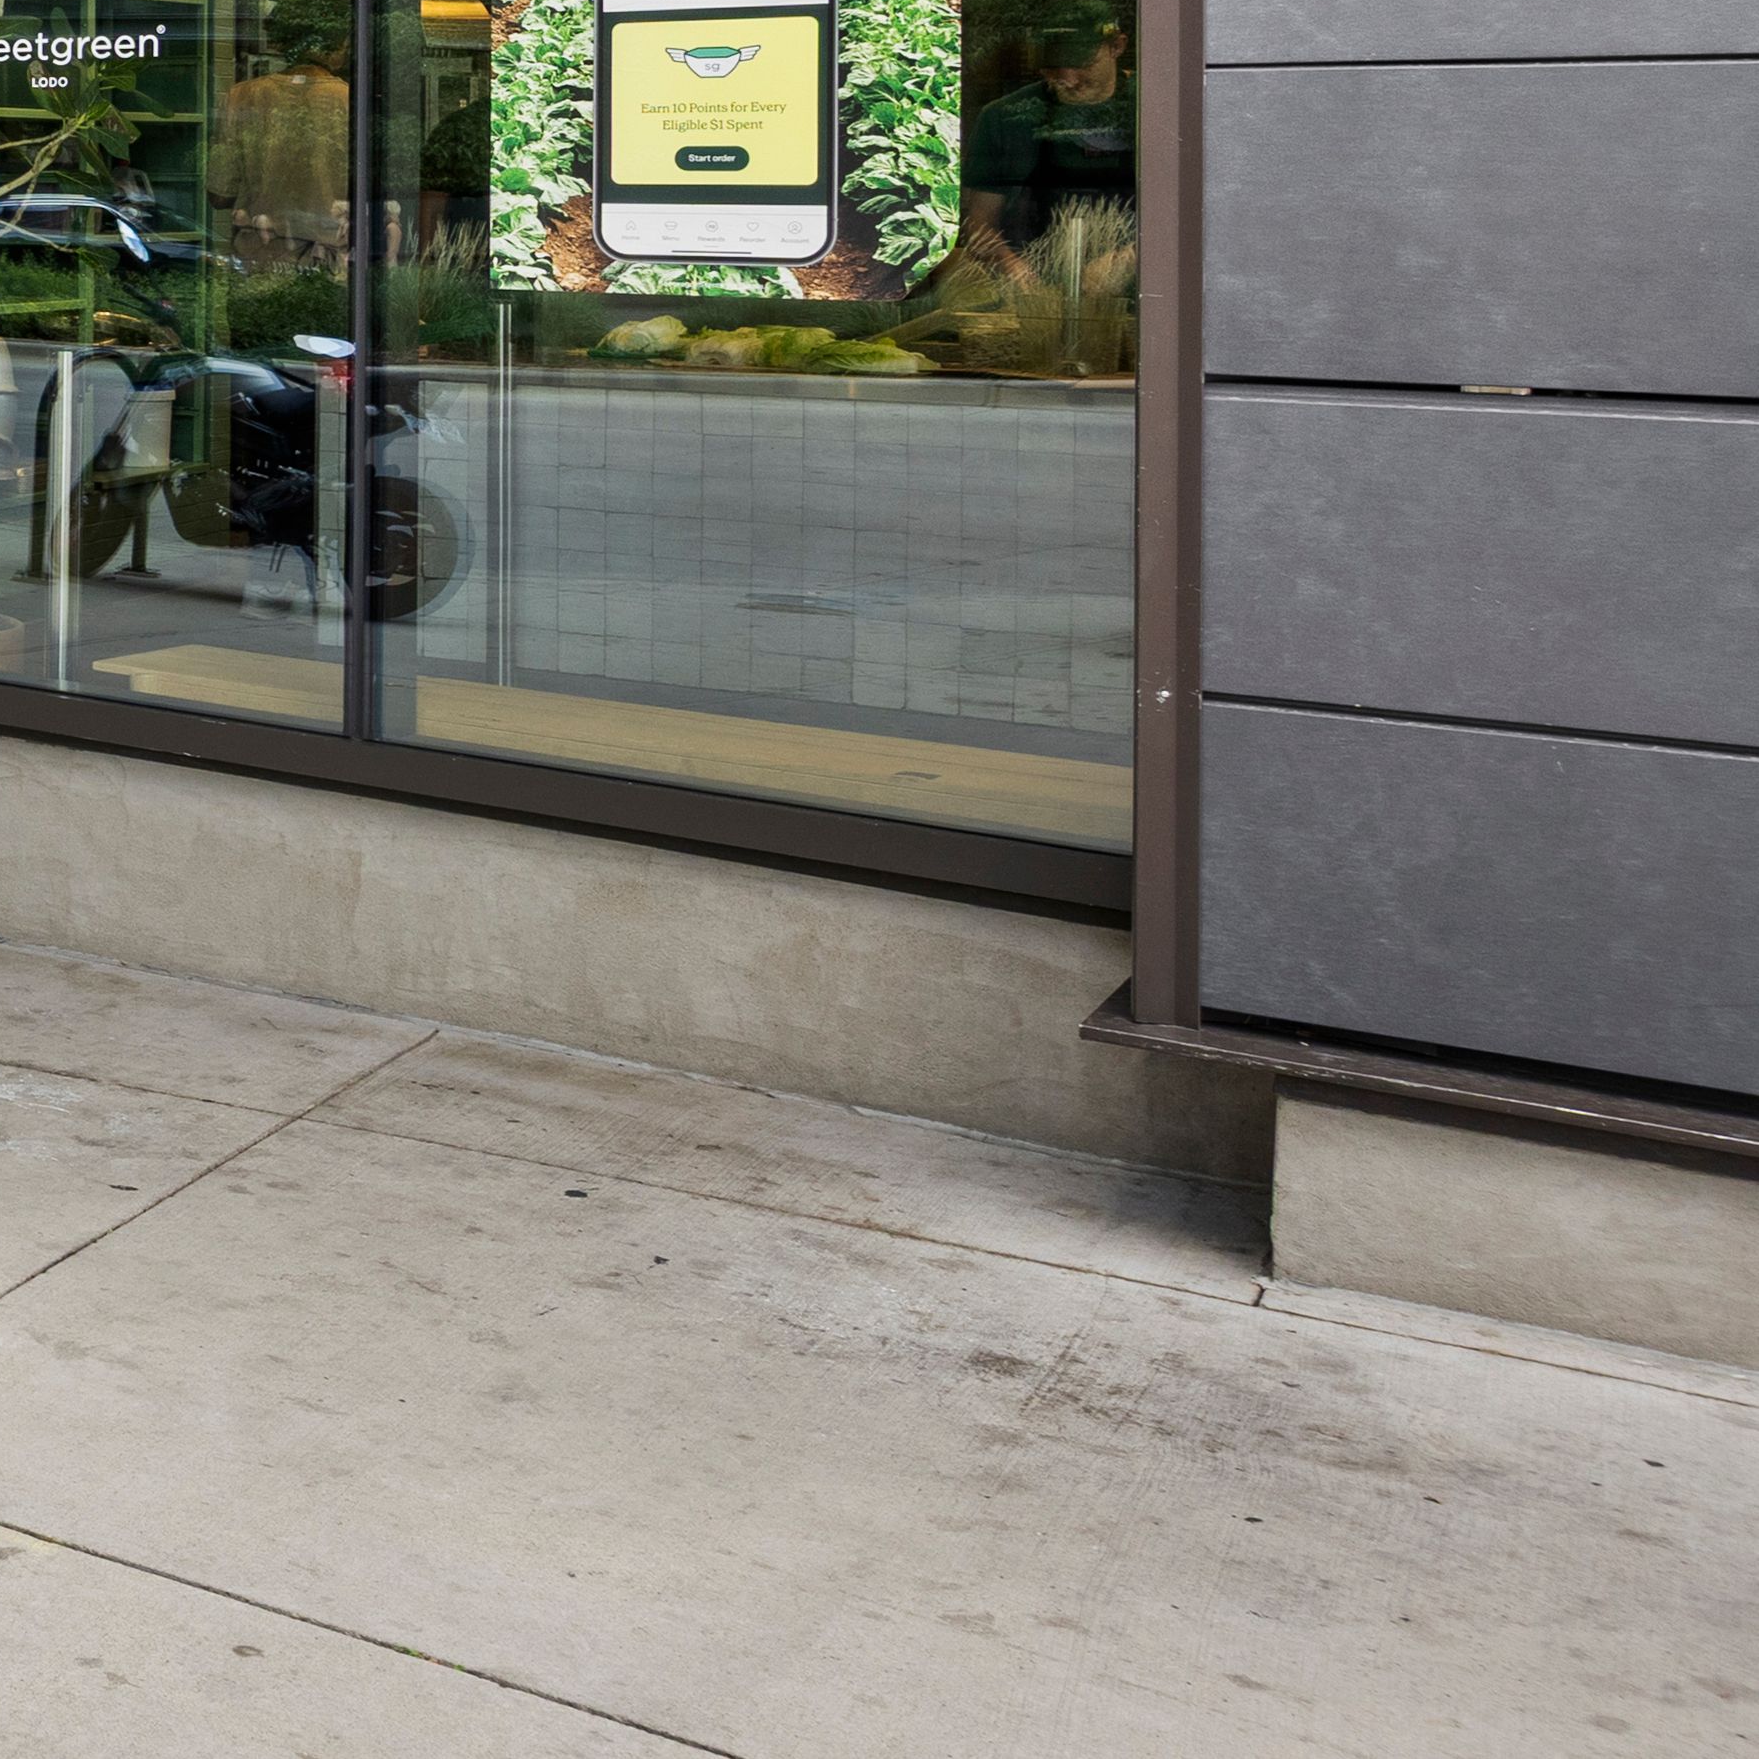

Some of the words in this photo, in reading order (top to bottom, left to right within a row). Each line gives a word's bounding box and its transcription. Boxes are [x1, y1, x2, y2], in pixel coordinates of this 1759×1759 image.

[704, 62, 720, 72] sg
[31, 76, 69, 88] LODO
[641, 103, 670, 114] Earn
[672, 103, 687, 113] 10
[689, 102, 728, 113] Points
[730, 101, 748, 113] for
[751, 101, 787, 115] Every
[662, 120, 708, 133] Eligible
[709, 119, 724, 131] $1
[726, 120, 763, 133] Spent
[688, 153, 712, 163] Start
[712, 153, 737, 163] order
